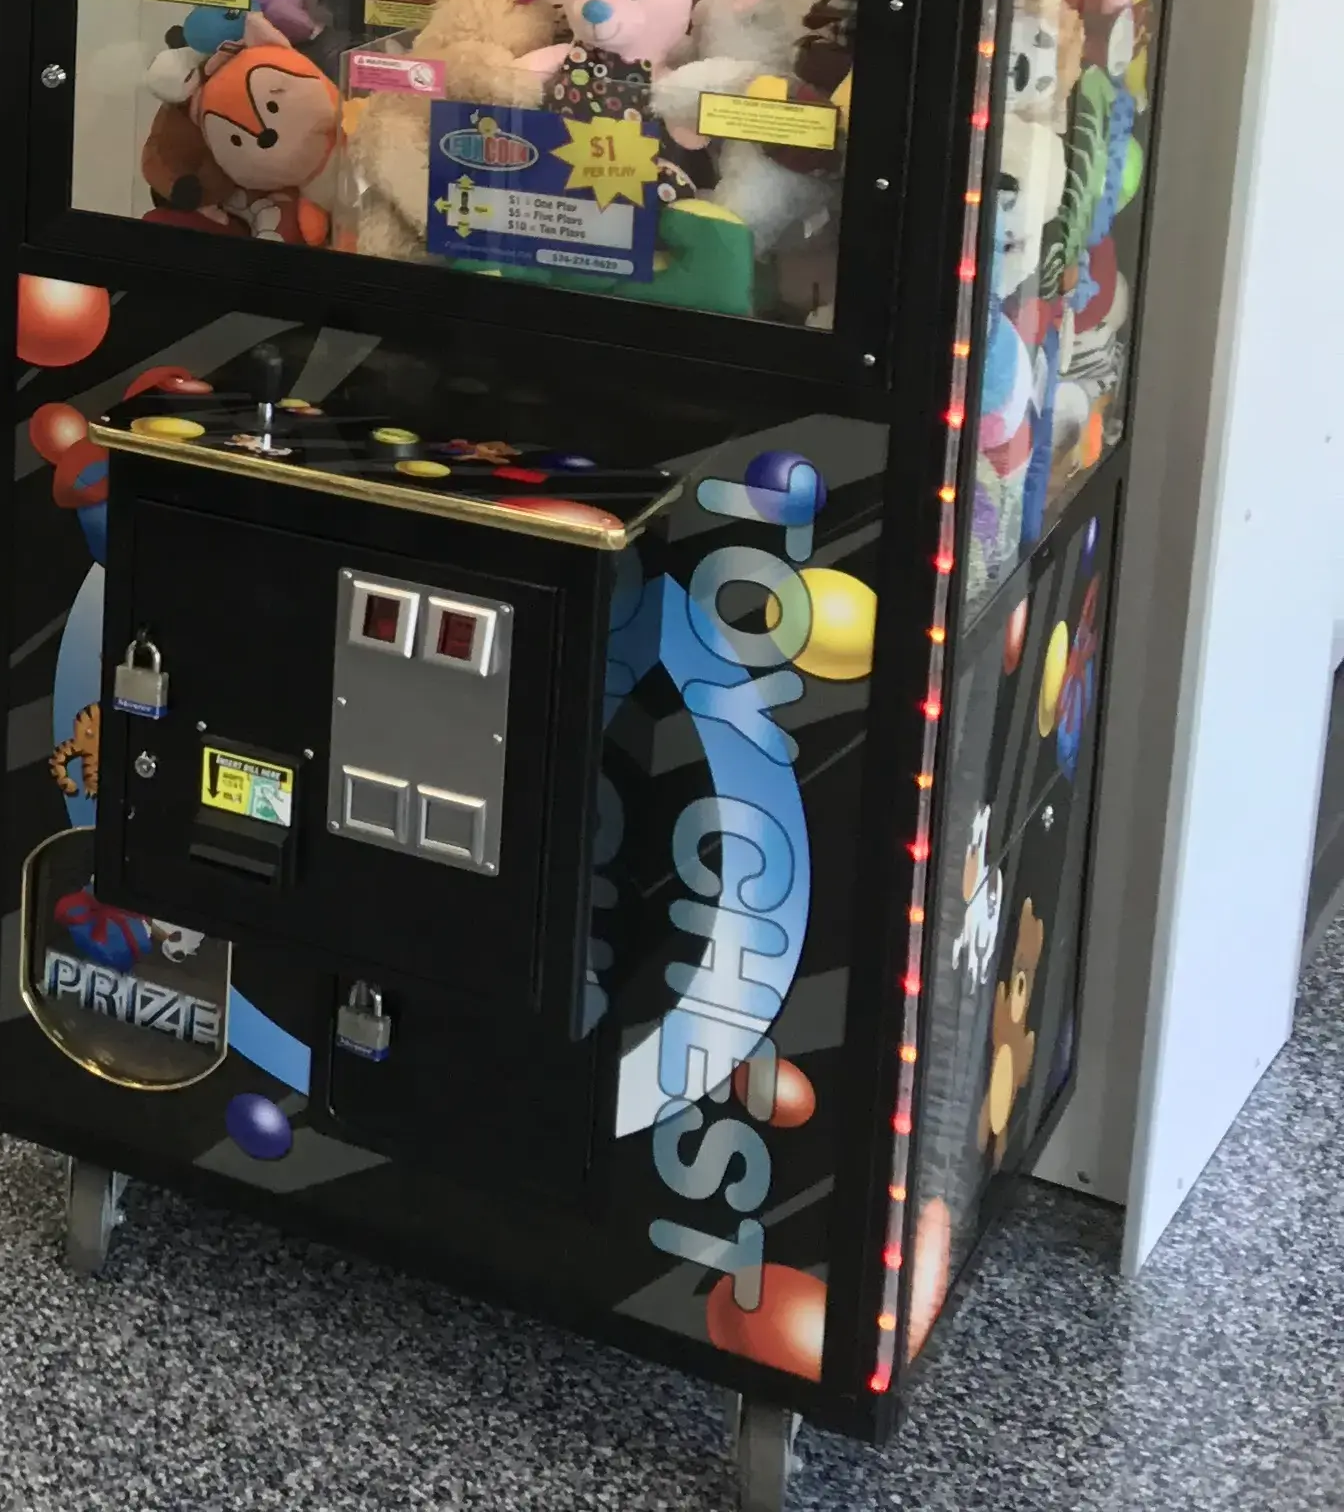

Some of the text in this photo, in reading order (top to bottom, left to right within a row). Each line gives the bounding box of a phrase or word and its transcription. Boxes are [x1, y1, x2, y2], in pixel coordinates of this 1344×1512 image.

[590, 135, 616, 162] $1
[582, 167, 636, 178] PER PLAY
[508, 195, 578, 212] $1 One Play
[508, 208, 584, 226] $5 Five Plays
[507, 220, 586, 239] $10 Ten Plays
[216, 754, 281, 780] INSERT BILL HERE
[646, 458, 828, 1312] TOY CHEST
[44, 946, 223, 1049] PRIZE
